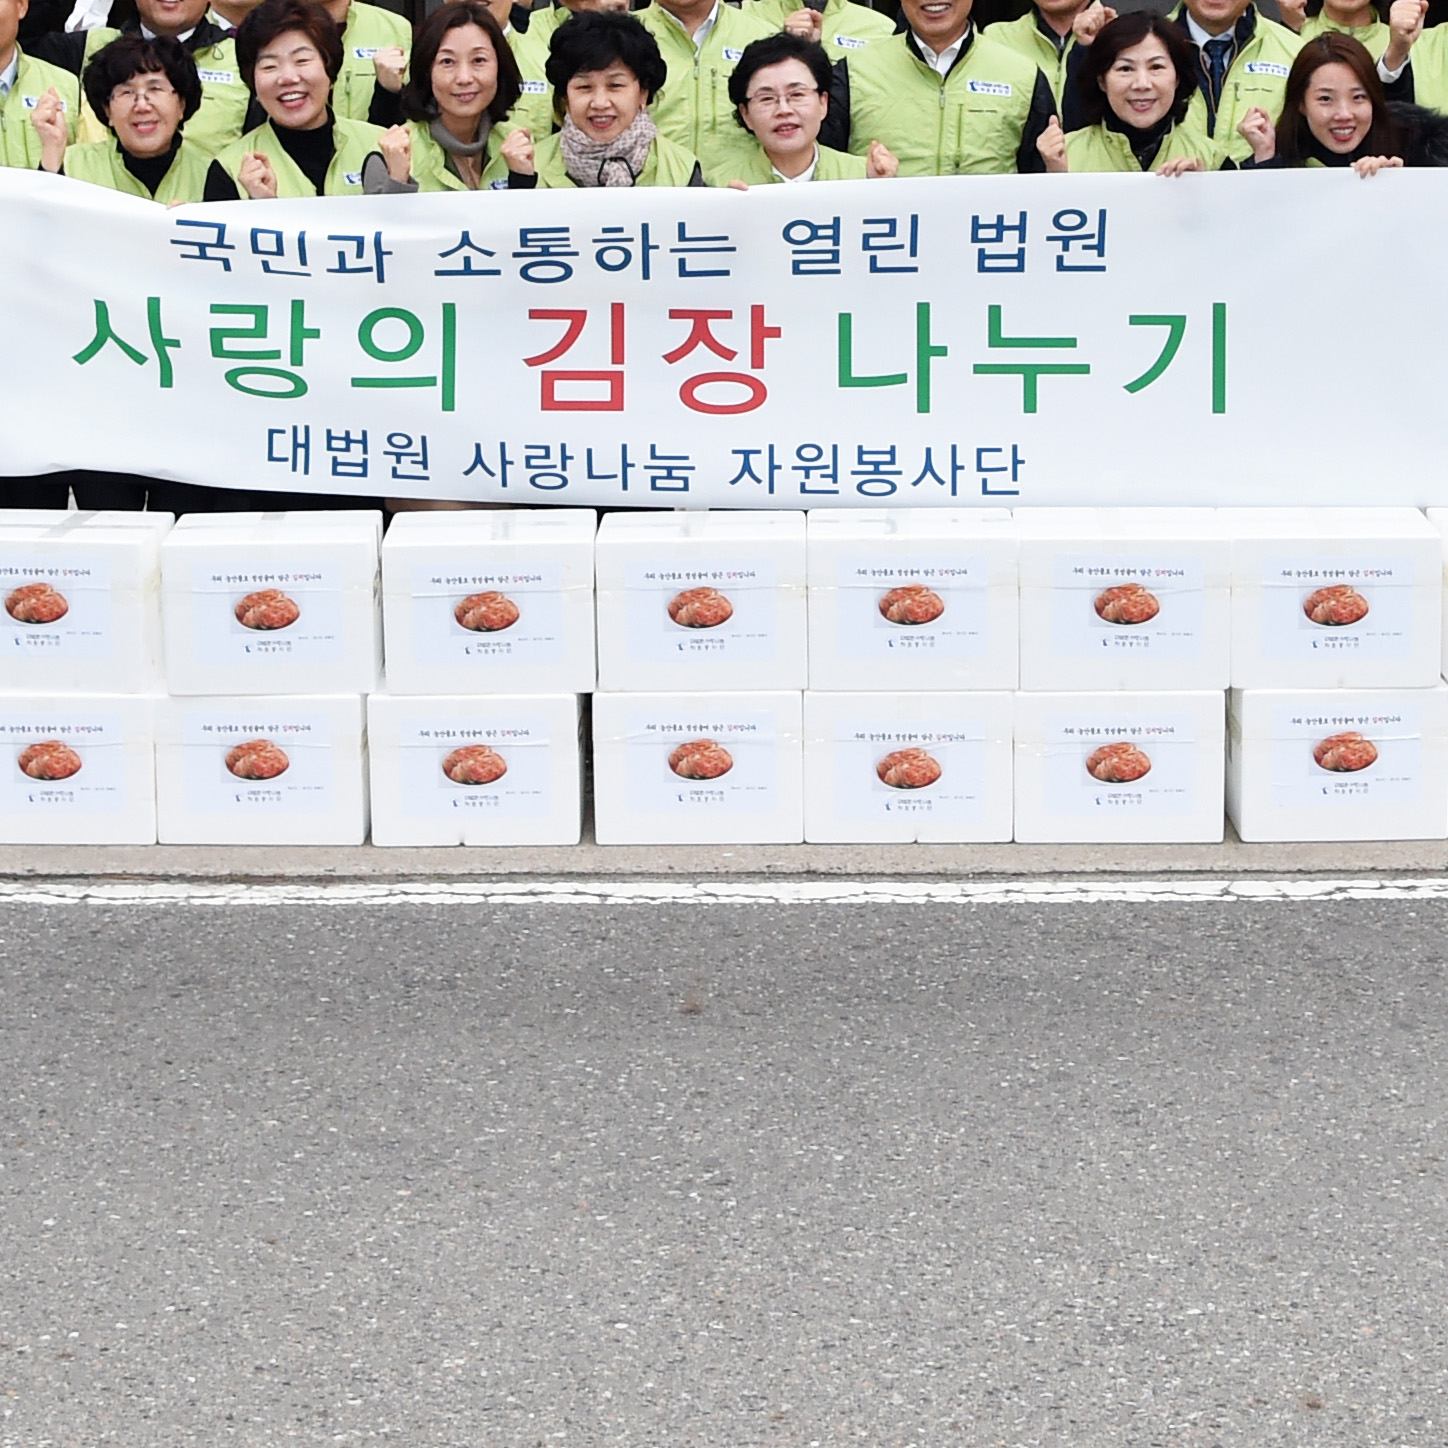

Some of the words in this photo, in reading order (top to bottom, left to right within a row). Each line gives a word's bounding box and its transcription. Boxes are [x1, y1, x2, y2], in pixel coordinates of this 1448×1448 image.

[169, 218, 394, 284] 국민과
[433, 221, 737, 284] 소통하는
[781, 213, 919, 276] 열린
[970, 208, 1107, 274] 법원
[71, 296, 457, 412] 사랑의
[522, 302, 782, 415] 김장
[837, 301, 1227, 415] 나누기
[267, 424, 431, 481] 대법원
[462, 441, 696, 492] 사랑나눔
[728, 443, 1026, 497] 자원봉사단
